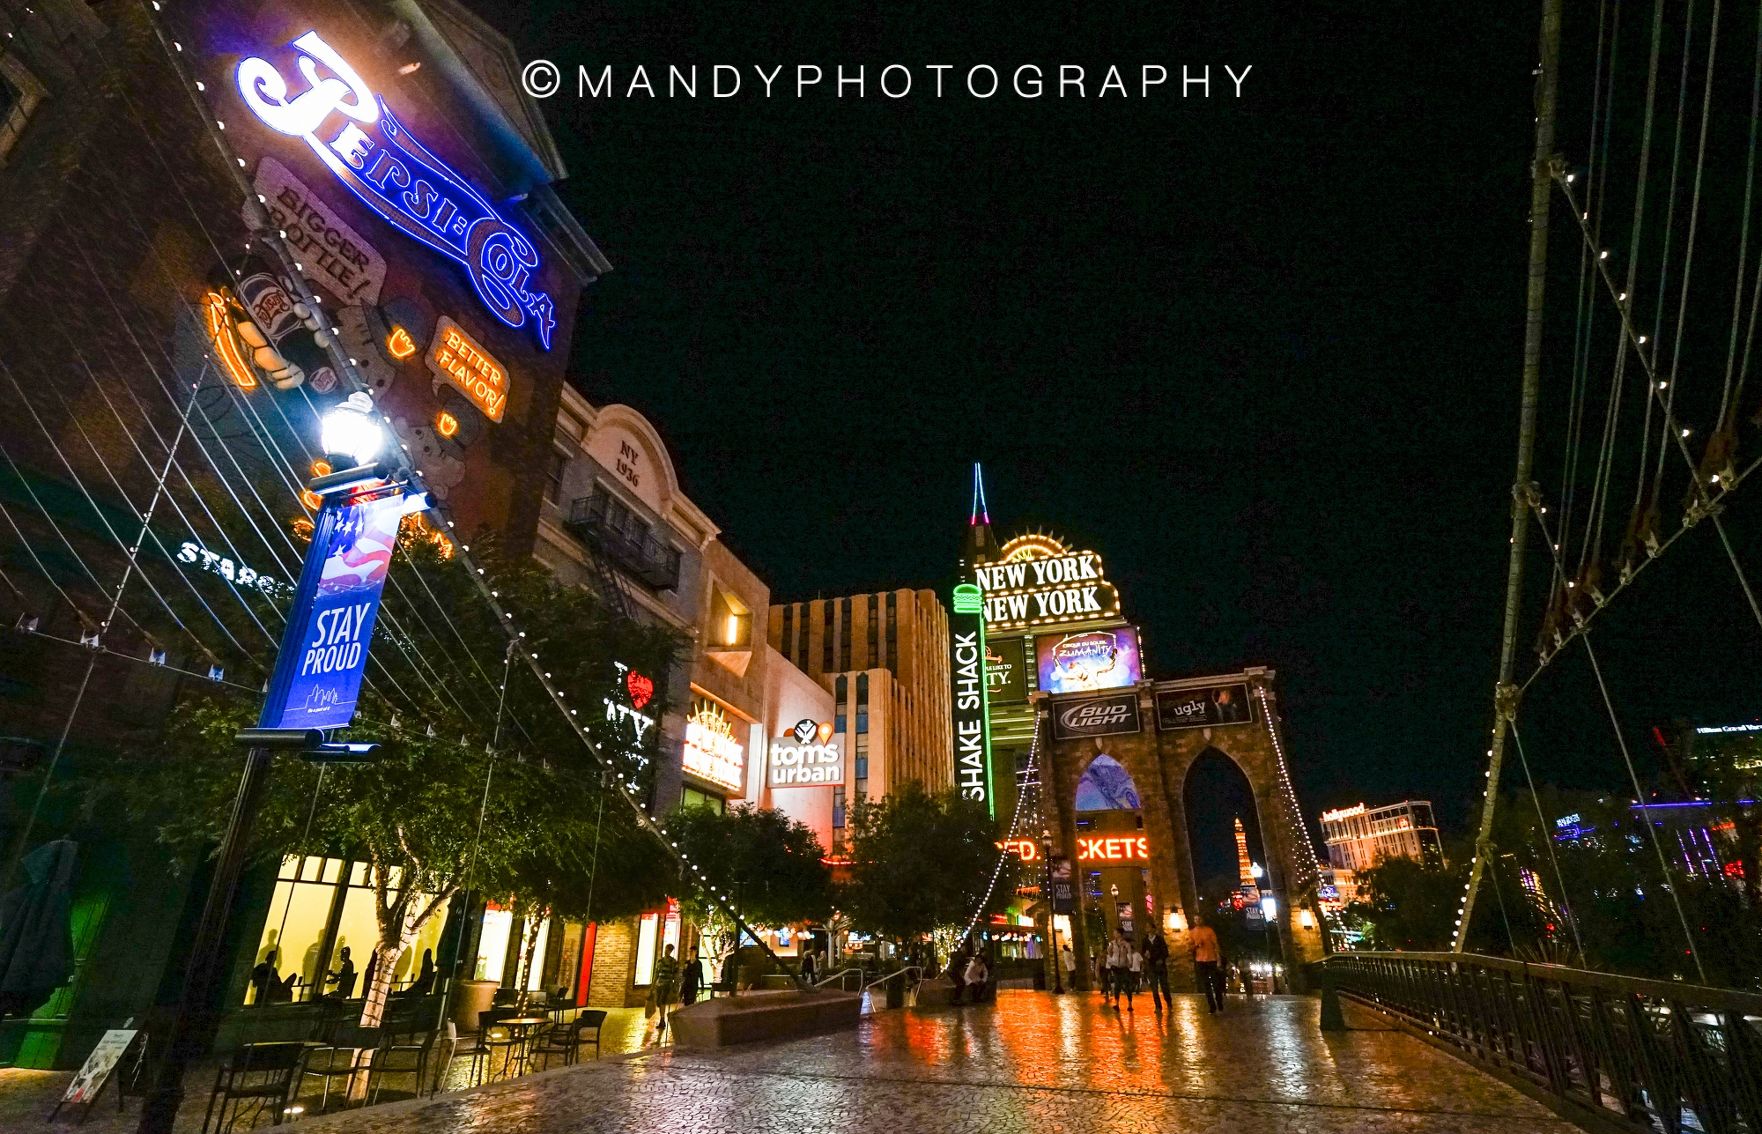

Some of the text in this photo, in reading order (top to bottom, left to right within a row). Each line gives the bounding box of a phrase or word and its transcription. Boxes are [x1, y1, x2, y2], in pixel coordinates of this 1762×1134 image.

[277, 188, 370, 273] BIGGER
[446, 331, 501, 385] BETTER
[438, 351, 505, 416] FLAVOR!
[620, 440, 639, 466] NY
[616, 458, 640, 487] 1936
[974, 554, 1099, 592] NEW YORK
[982, 586, 1102, 623] NEW YORK
[312, 602, 371, 648] STAY
[301, 641, 361, 676] PROUD
[1059, 645, 1112, 657] ZUMANITY
[955, 631, 985, 802] SHAKE SHACK
[1069, 713, 1131, 728] LIGHT
[1079, 704, 1128, 718] BUD
[1173, 700, 1206, 717] ugly
[770, 743, 839, 766] toms
[772, 764, 840, 784] urban
